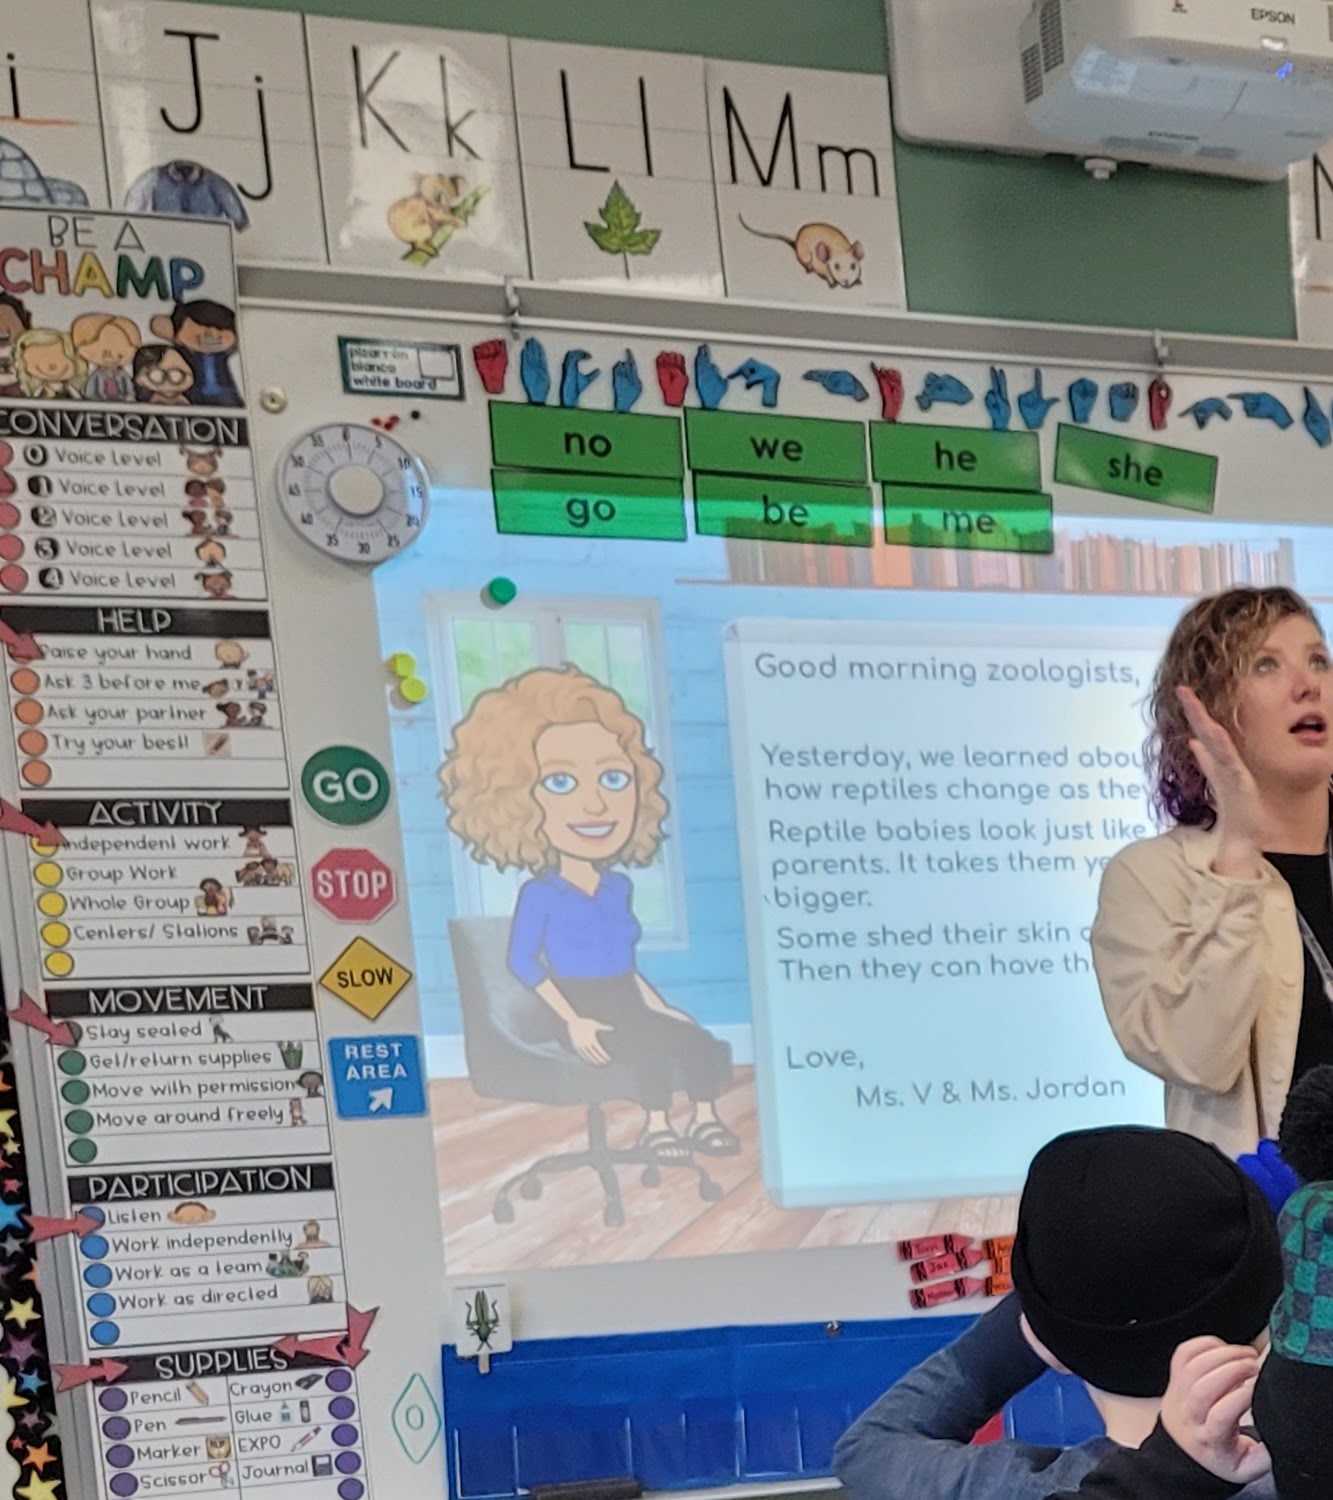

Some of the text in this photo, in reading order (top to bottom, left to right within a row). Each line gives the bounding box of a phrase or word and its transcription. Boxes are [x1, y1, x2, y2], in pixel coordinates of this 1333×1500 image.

[1251, 9, 1296, 25] EPSON
[48, 215, 145, 253] BE A
[0, 247, 206, 302] CHAMP
[564, 432, 612, 457] no
[750, 435, 804, 461] we
[55, 448, 162, 468] Voice Level
[935, 442, 977, 472] he
[1107, 454, 1163, 487] she
[58, 479, 166, 498] Voice Level
[61, 509, 169, 528] Voice Level
[566, 498, 616, 528] go
[763, 495, 809, 526] be
[943, 510, 996, 534] me
[66, 541, 172, 559] Voice Level
[69, 571, 176, 590] Voice Level
[98, 609, 172, 633] HELP
[95, 643, 192, 666] your hand
[44, 673, 201, 692] Ask before me
[755, 653, 1141, 689] Good morning zoologists,
[85, 705, 207, 726] your partner
[52, 734, 85, 756] Try
[92, 736, 136, 757] your
[761, 743, 1069, 772] Yesterday, we learned
[312, 768, 378, 803] GO
[765, 778, 1090, 805] how reptiles change as
[89, 801, 224, 826] ACTIVITY
[769, 817, 1147, 846] Reptile babies look just like
[184, 836, 231, 851] work
[66, 866, 177, 885] Group Work
[772, 855, 891, 882] parents.
[900, 852, 918, 873] It
[926, 852, 999, 874] takes
[1008, 852, 1076, 873] them
[317, 870, 388, 898] STOP
[70, 895, 190, 915] Whole Group
[774, 886, 873, 914] bigger.
[162, 923, 238, 940] Stations
[778, 927, 858, 950] Some
[868, 924, 933, 946] shed
[943, 922, 1008, 945] their
[1017, 920, 1071, 943] skin
[337, 967, 394, 988] SLOW
[780, 959, 851, 982] Then
[862, 958, 922, 984] they
[931, 960, 982, 979] can
[991, 955, 1054, 977] have
[89, 986, 268, 1014] MOVEMENT
[86, 1023, 202, 1045] Stay seated
[90, 1050, 272, 1070] Get/return supplies
[344, 1043, 403, 1060] REST
[786, 1045, 864, 1071] Love,
[346, 1064, 408, 1080] AREA
[92, 1077, 297, 1100] Move with permission
[857, 1074, 1127, 1108] Ms. V & Ms. Jordan
[96, 1107, 285, 1128] Move around freely
[88, 1165, 313, 1200] PARTICIPATION
[108, 1208, 162, 1226] Listen
[112, 1230, 293, 1254] Work independently
[115, 1260, 263, 1282] Work as team
[119, 1286, 278, 1310] Work as directed
[155, 1349, 288, 1379] SUPPLIES
[130, 1388, 182, 1406] Pencil
[230, 1379, 293, 1400] Crayon
[135, 1417, 167, 1433] Pen
[235, 1408, 273, 1425] Glue
[137, 1443, 201, 1461] Marker
[238, 1435, 281, 1453] EXPO
[242, 1460, 309, 1480] Journal
